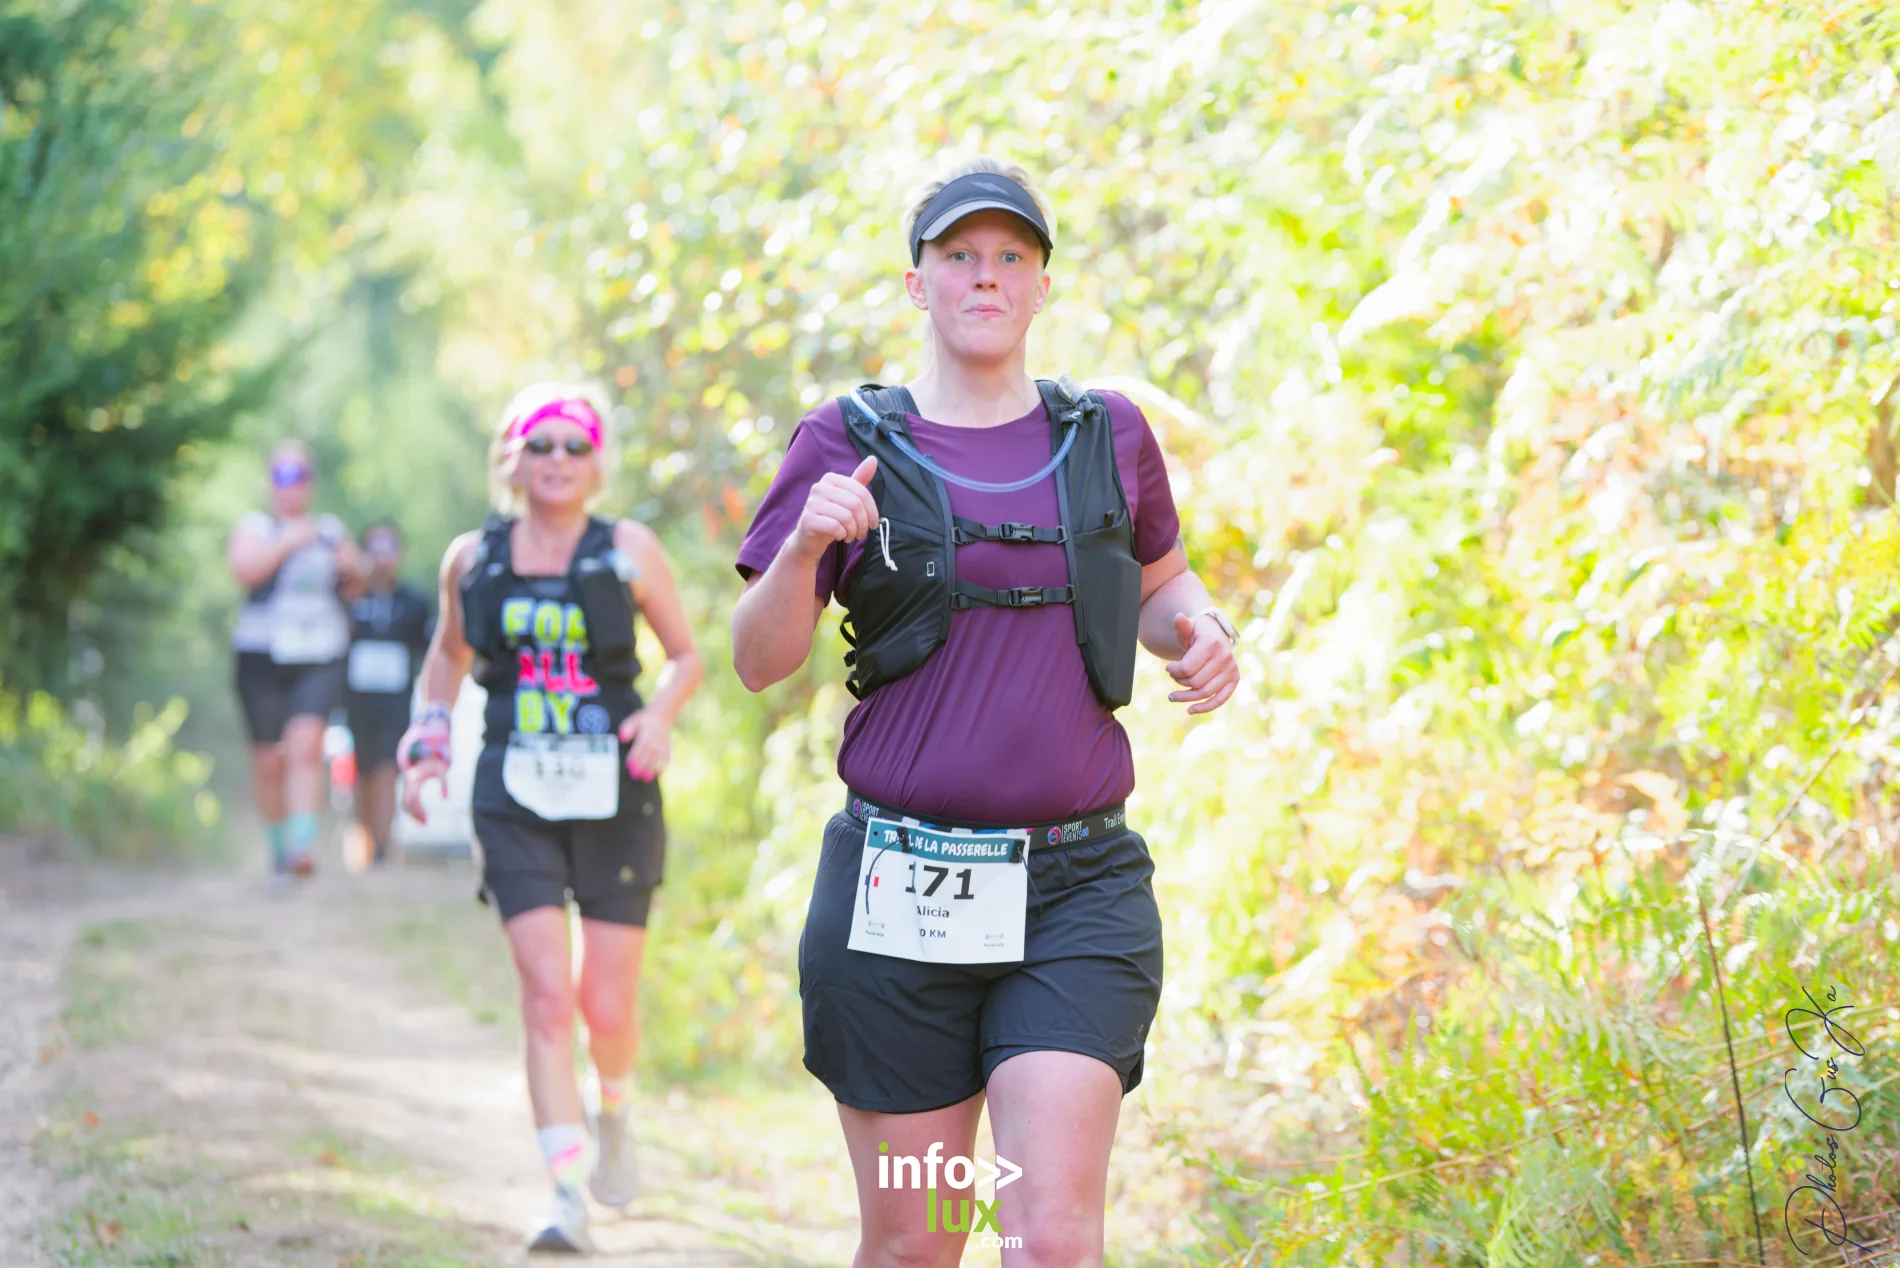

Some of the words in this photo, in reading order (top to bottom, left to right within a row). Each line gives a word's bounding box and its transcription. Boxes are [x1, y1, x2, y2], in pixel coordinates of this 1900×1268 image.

[515, 688, 581, 736] BY
[862, 801, 880, 817] SPORT
[1063, 820, 1083, 834] SPORT
[1103, 813, 1118, 830] Trail
[924, 838, 938, 854] LA
[941, 842, 1008, 857] PASSERELLE
[929, 929, 946, 938] KM
